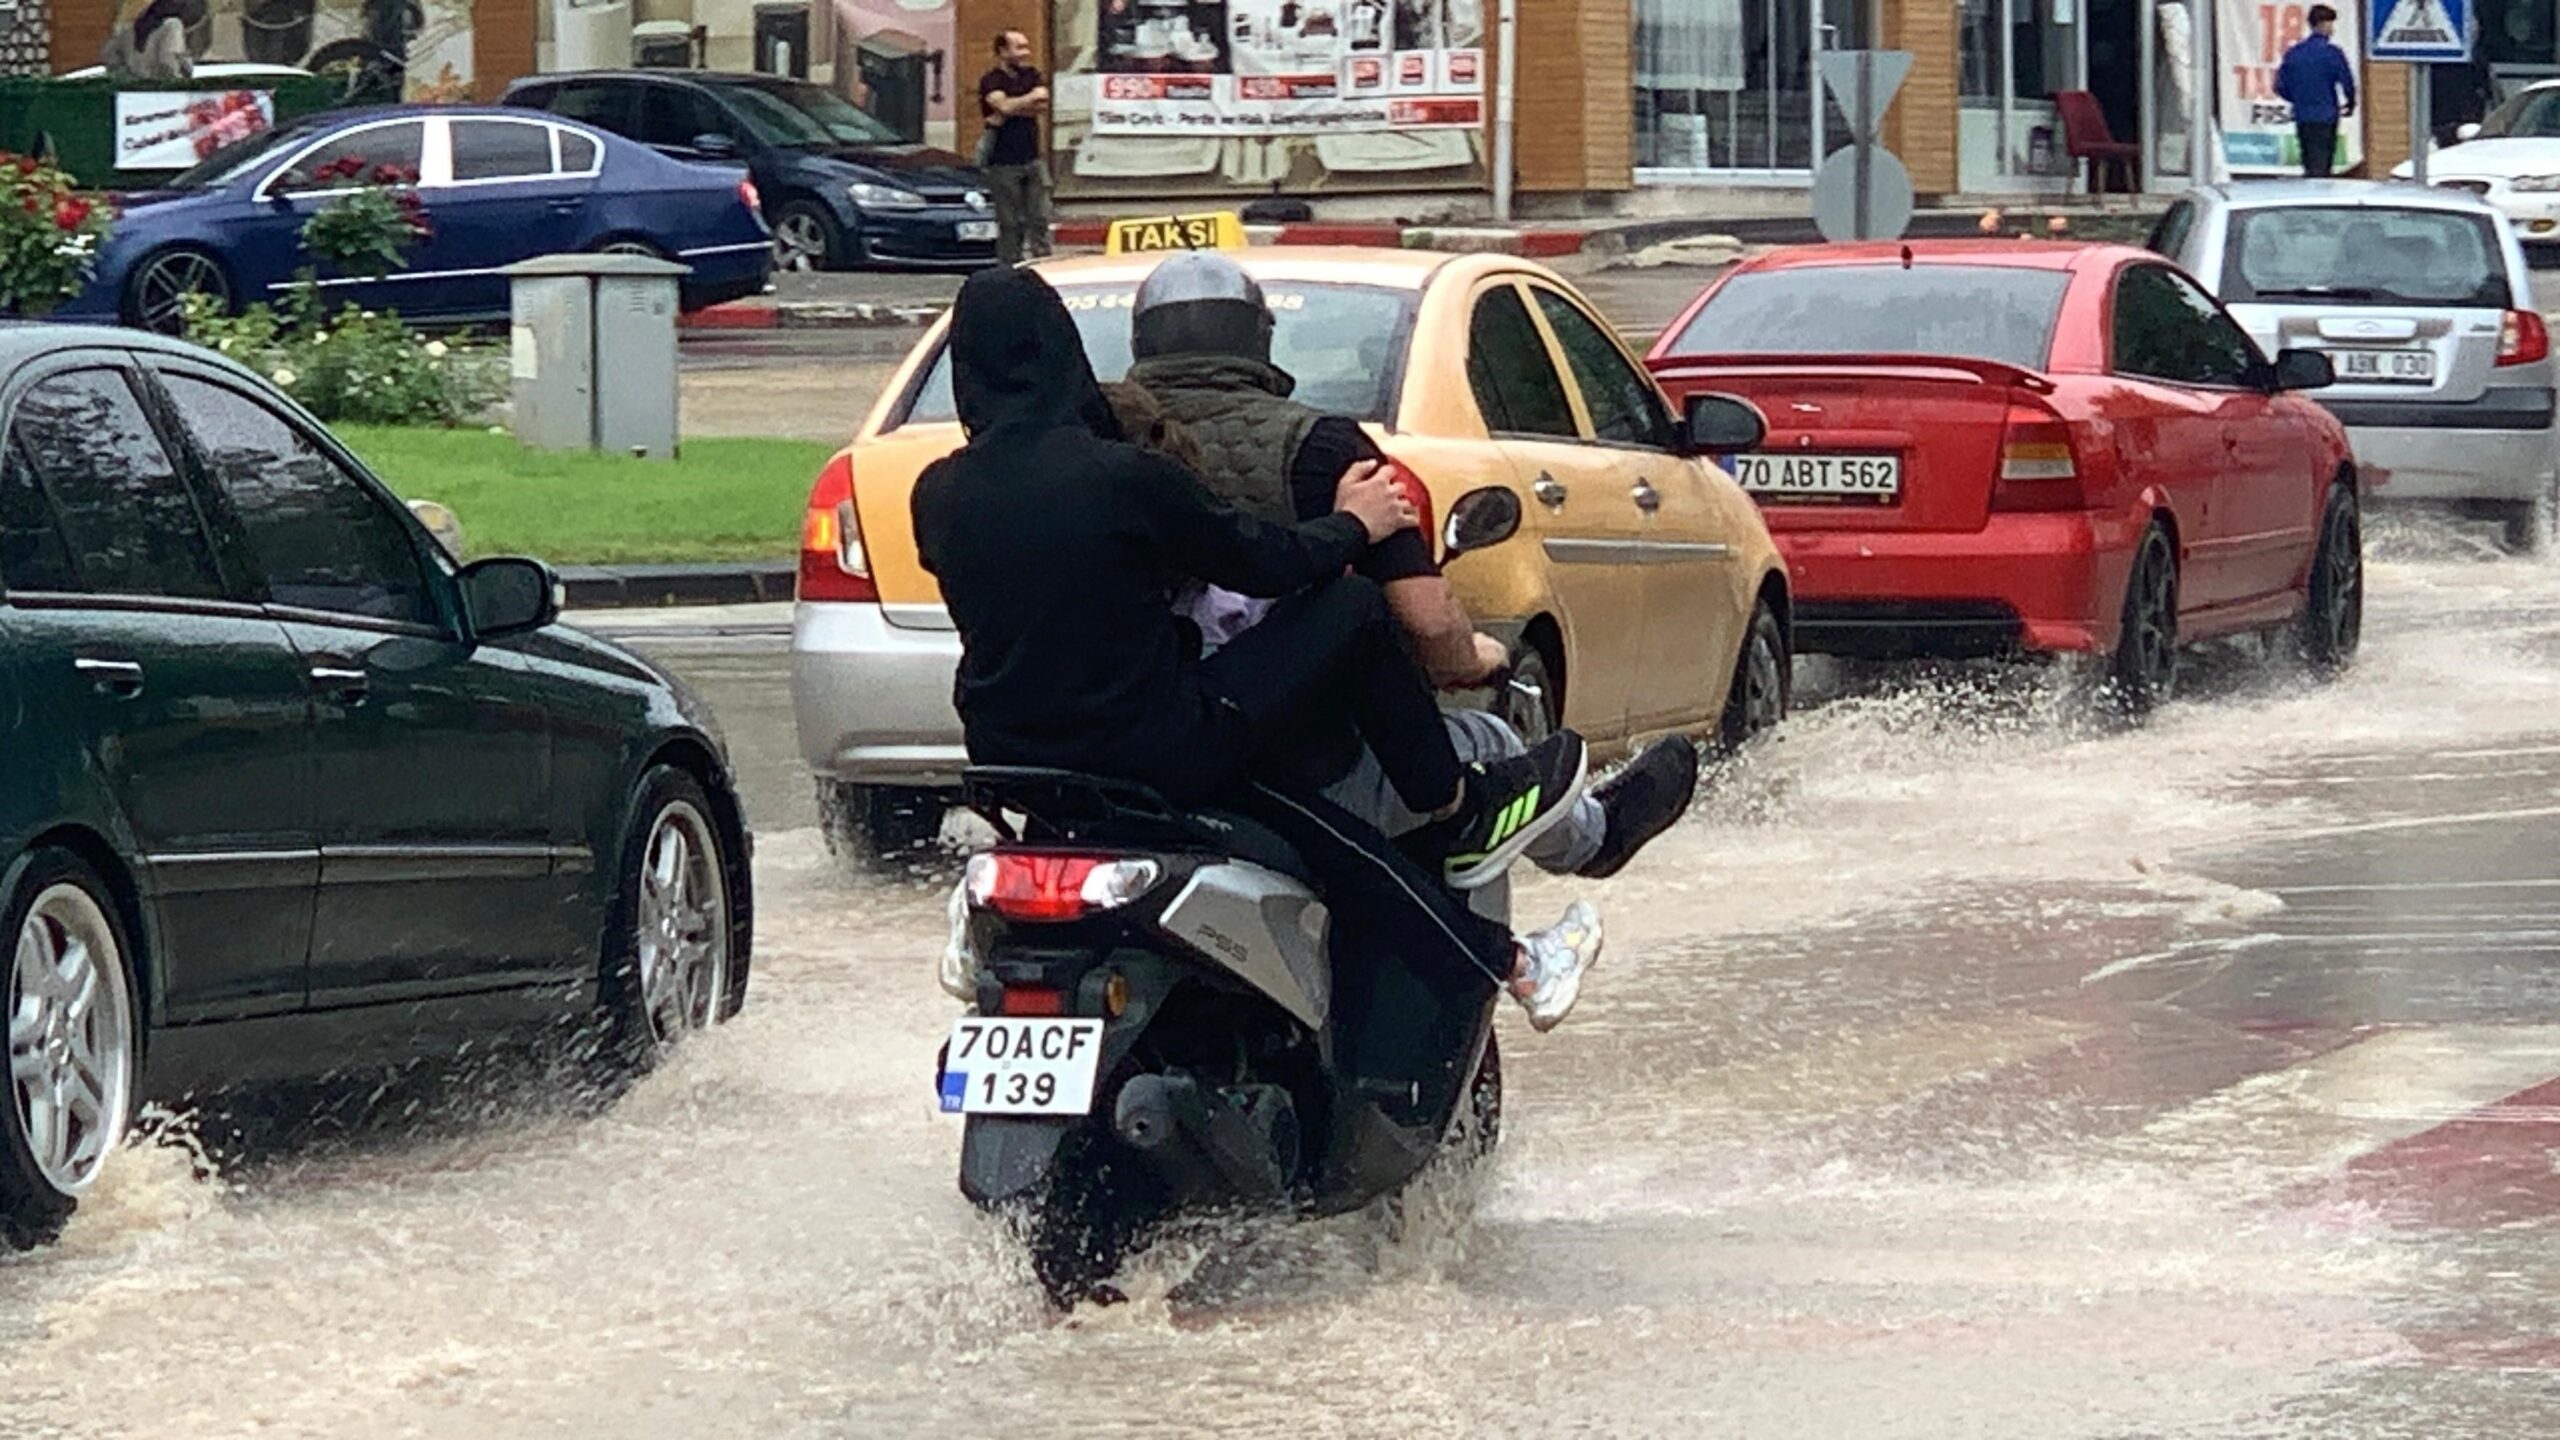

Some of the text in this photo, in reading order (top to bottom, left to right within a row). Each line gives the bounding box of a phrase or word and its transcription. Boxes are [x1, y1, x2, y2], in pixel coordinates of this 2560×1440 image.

[1737, 459, 1893, 488] 70 ABT 562
[959, 1025, 1094, 1060] 70ACF
[983, 1072, 1056, 1106] 139
